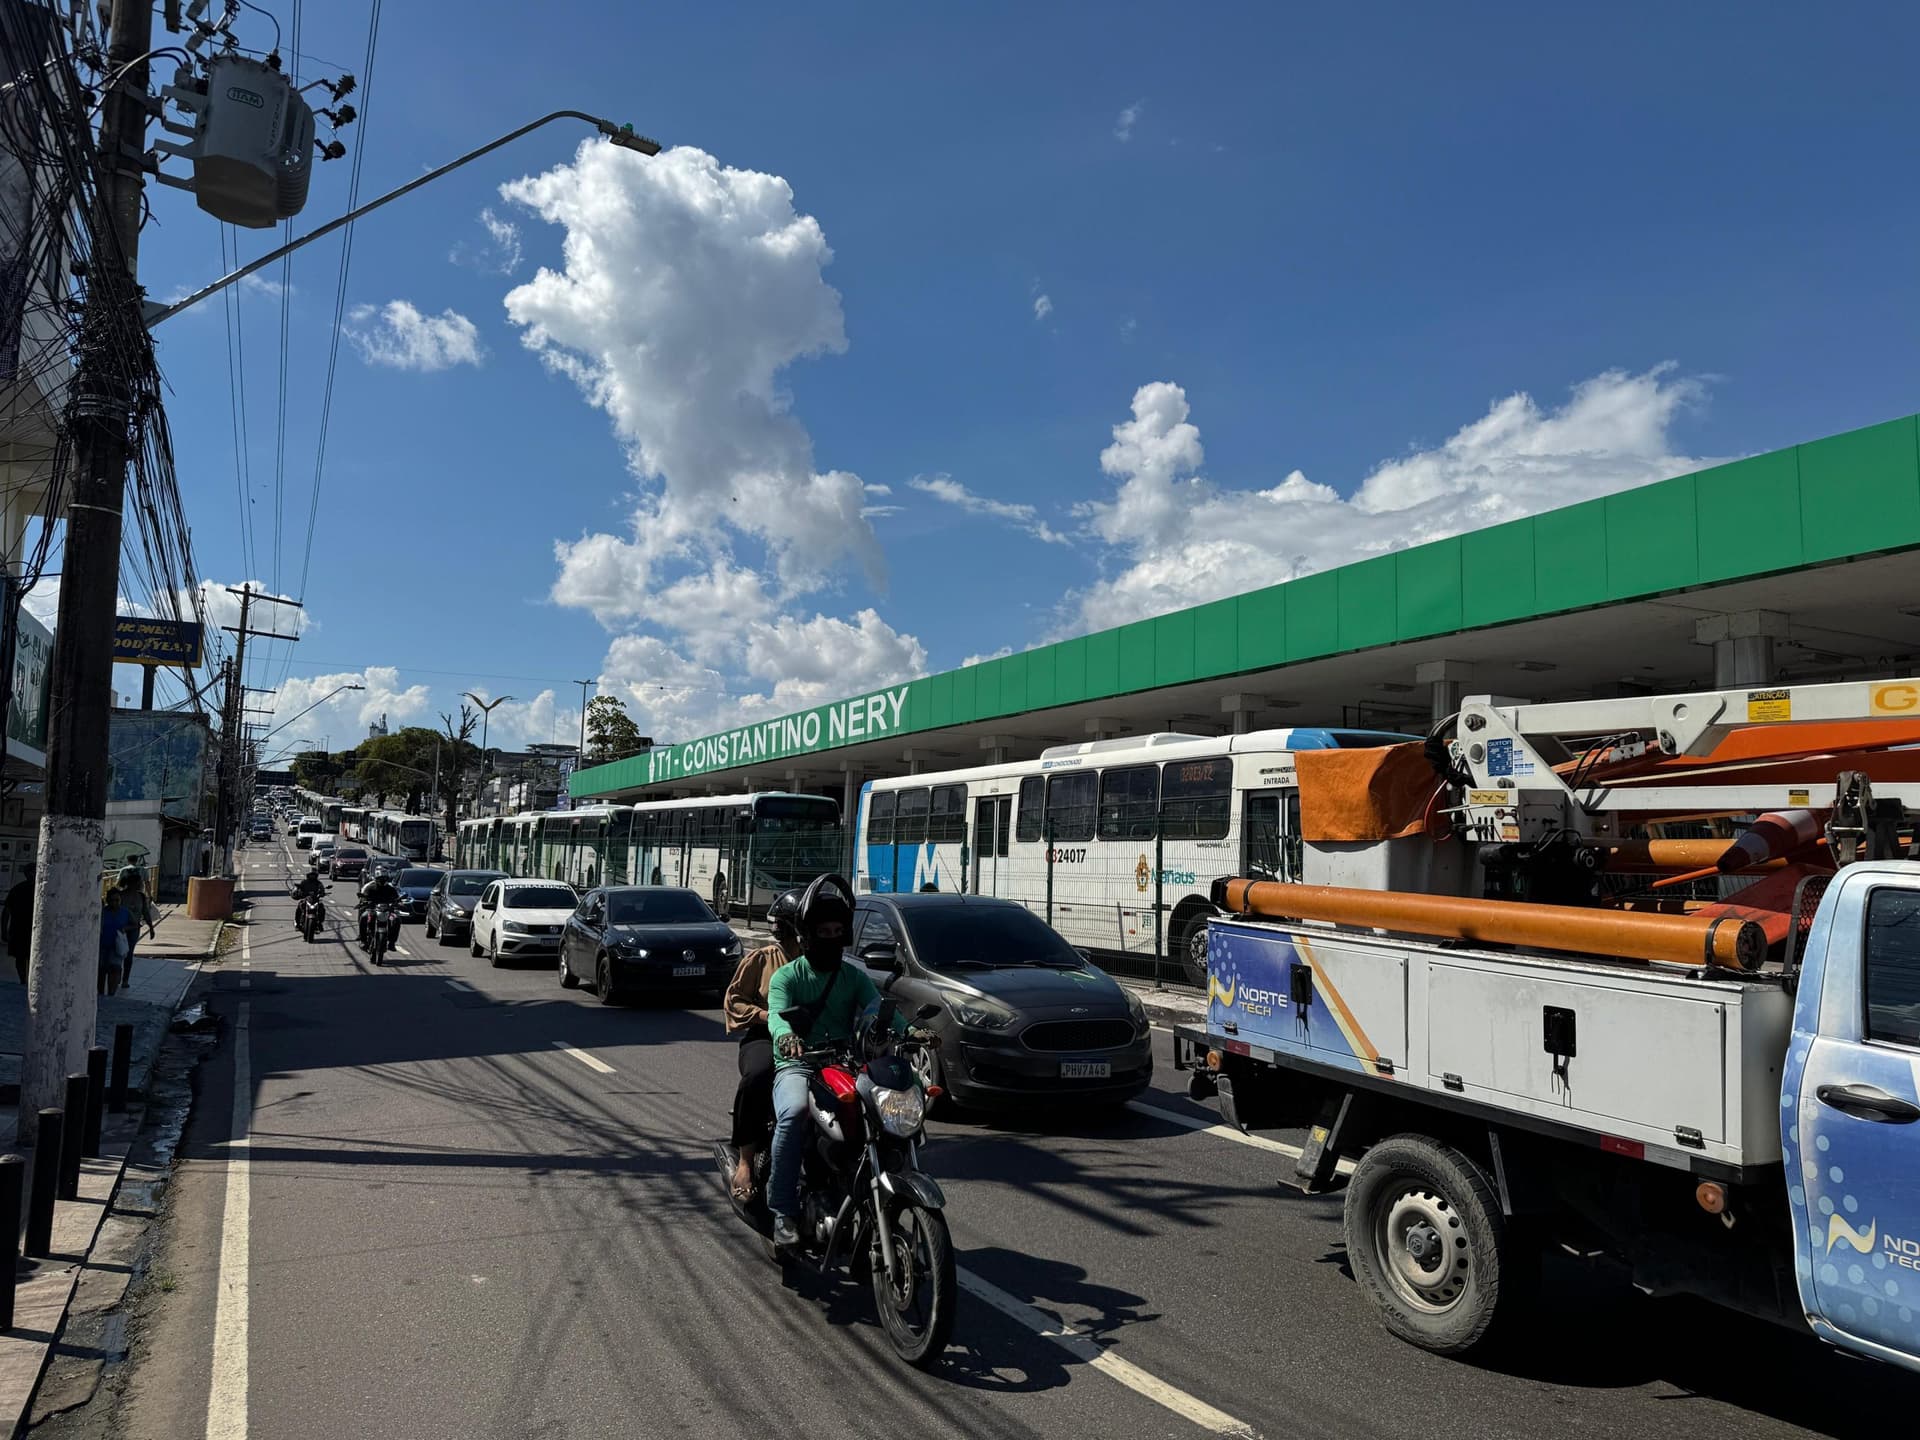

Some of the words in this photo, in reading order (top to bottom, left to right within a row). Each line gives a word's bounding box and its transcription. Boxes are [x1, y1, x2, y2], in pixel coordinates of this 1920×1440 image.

[657, 749, 671, 777] T1
[683, 712, 821, 772] CONSTANTINO
[829, 686, 909, 742] NERY
[1263, 777, 1290, 785] ENTRADA
[1239, 986, 1288, 1008] NORTE
[1240, 1001, 1272, 1016] TECH
